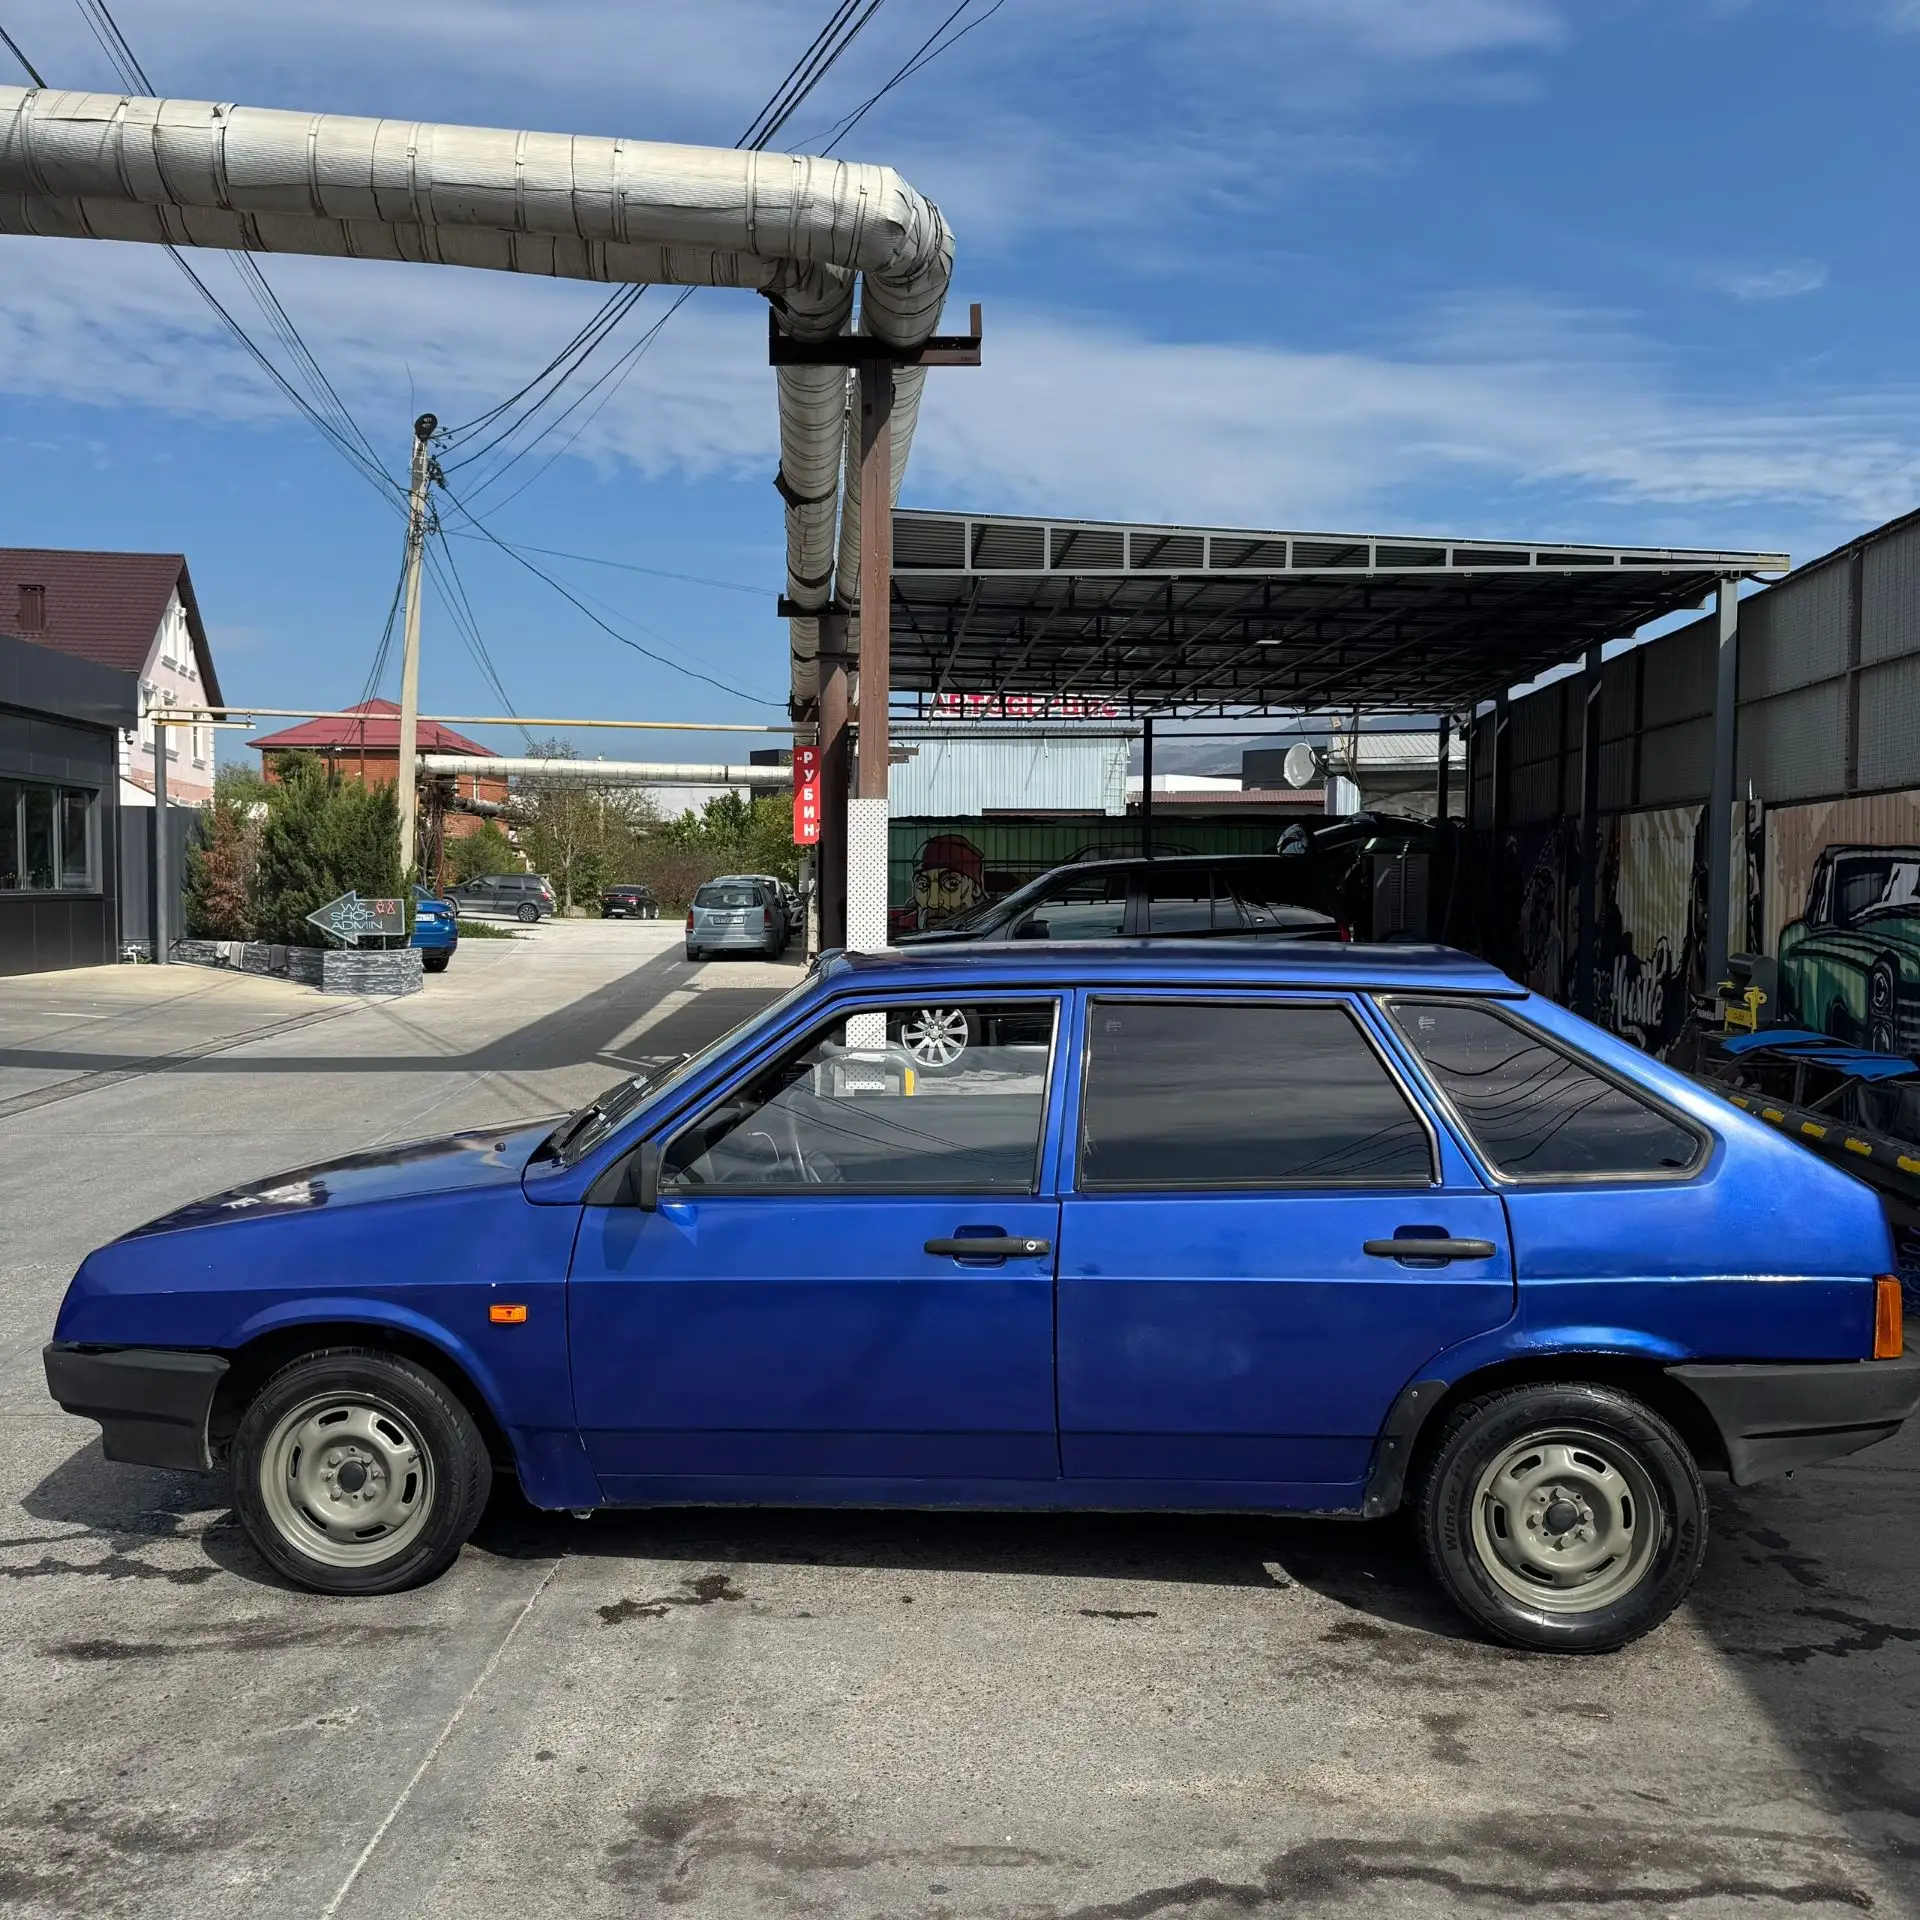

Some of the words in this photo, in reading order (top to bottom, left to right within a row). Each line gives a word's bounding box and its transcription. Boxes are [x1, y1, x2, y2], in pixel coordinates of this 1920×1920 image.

[340, 902, 366, 912] WC
[331, 911, 376, 921] SHOP
[331, 920, 383, 930] ADMIN
[1444, 1485, 1458, 1551] Winter
